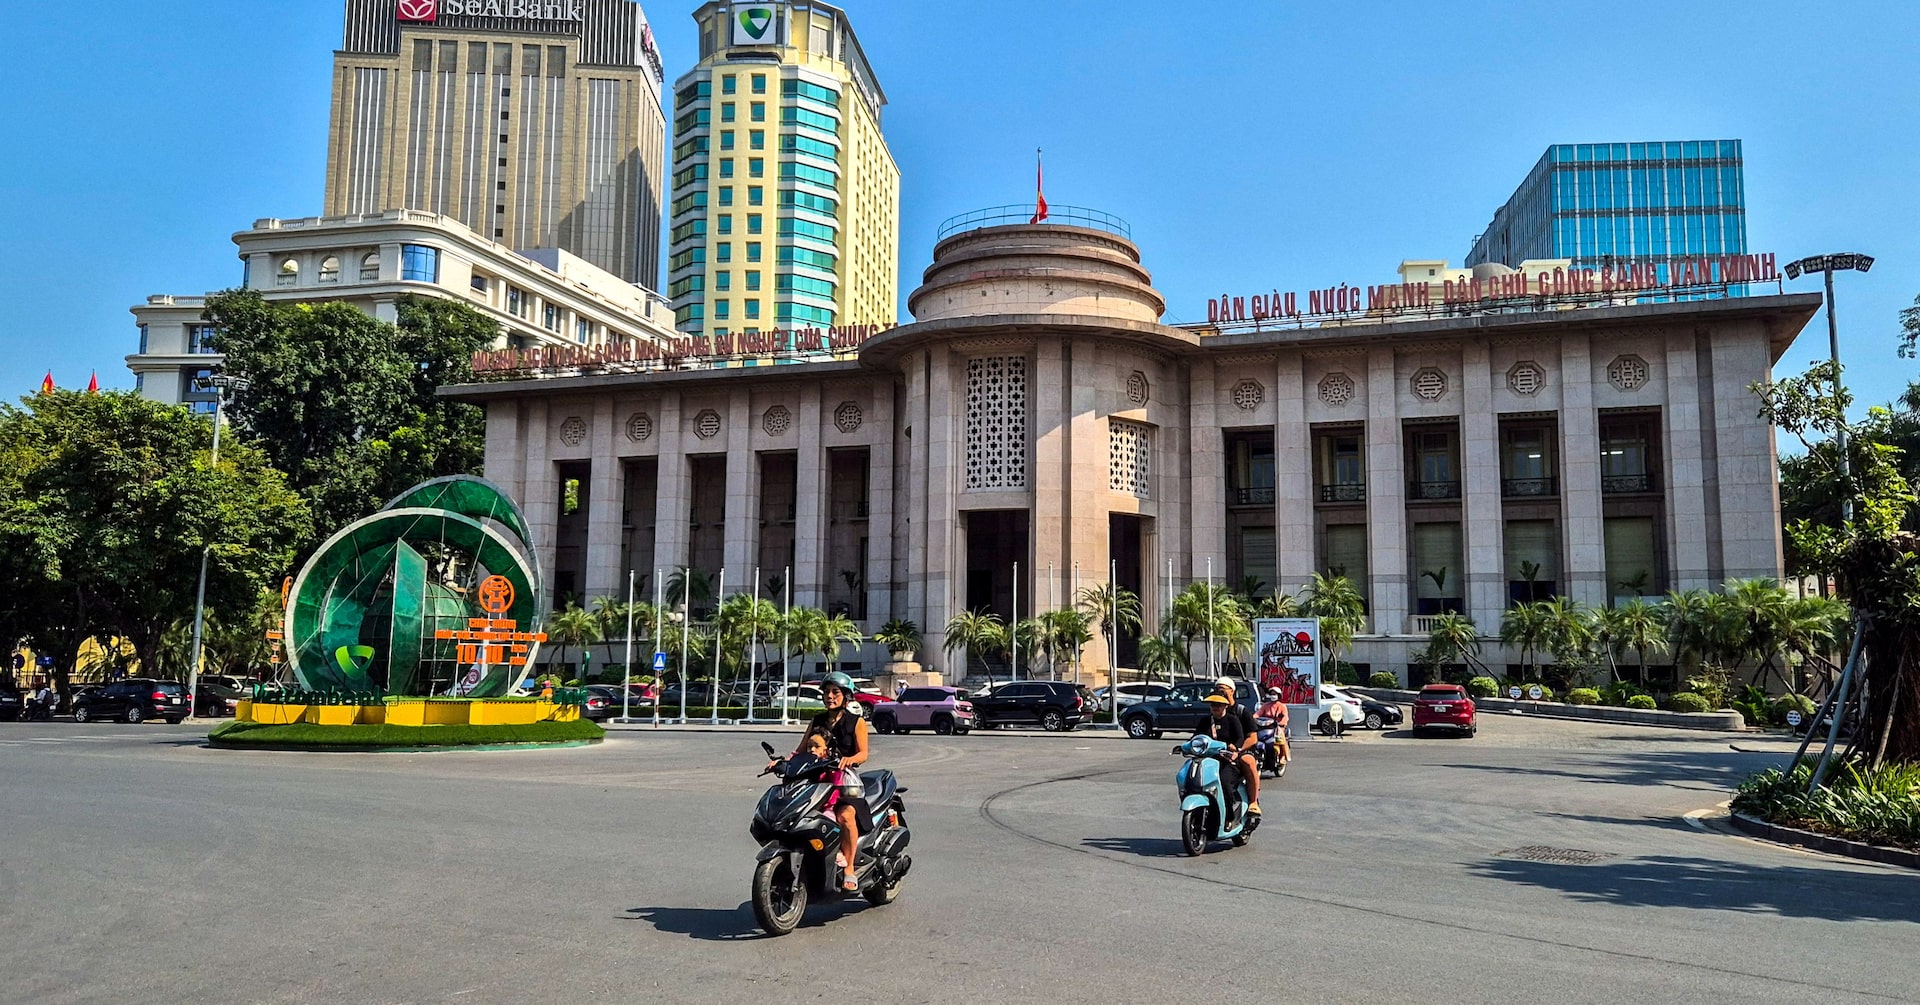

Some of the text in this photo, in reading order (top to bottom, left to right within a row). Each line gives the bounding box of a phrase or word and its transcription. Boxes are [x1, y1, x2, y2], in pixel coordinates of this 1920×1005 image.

[446, 0, 582, 21] SeABank
[1207, 294, 1245, 322] DÂN
[1252, 289, 1302, 320] GIÀU,
[1309, 282, 1360, 315] NƯỚC
[1443, 274, 1482, 305] DÂN
[1538, 266, 1595, 297] CÔNG
[1670, 255, 1712, 287] VĂN
[1719, 252, 1782, 284] MINH.
[666, 335, 710, 358] TRONG
[737, 326, 788, 354] NGHIỆP
[795, 322, 823, 350] CỦA
